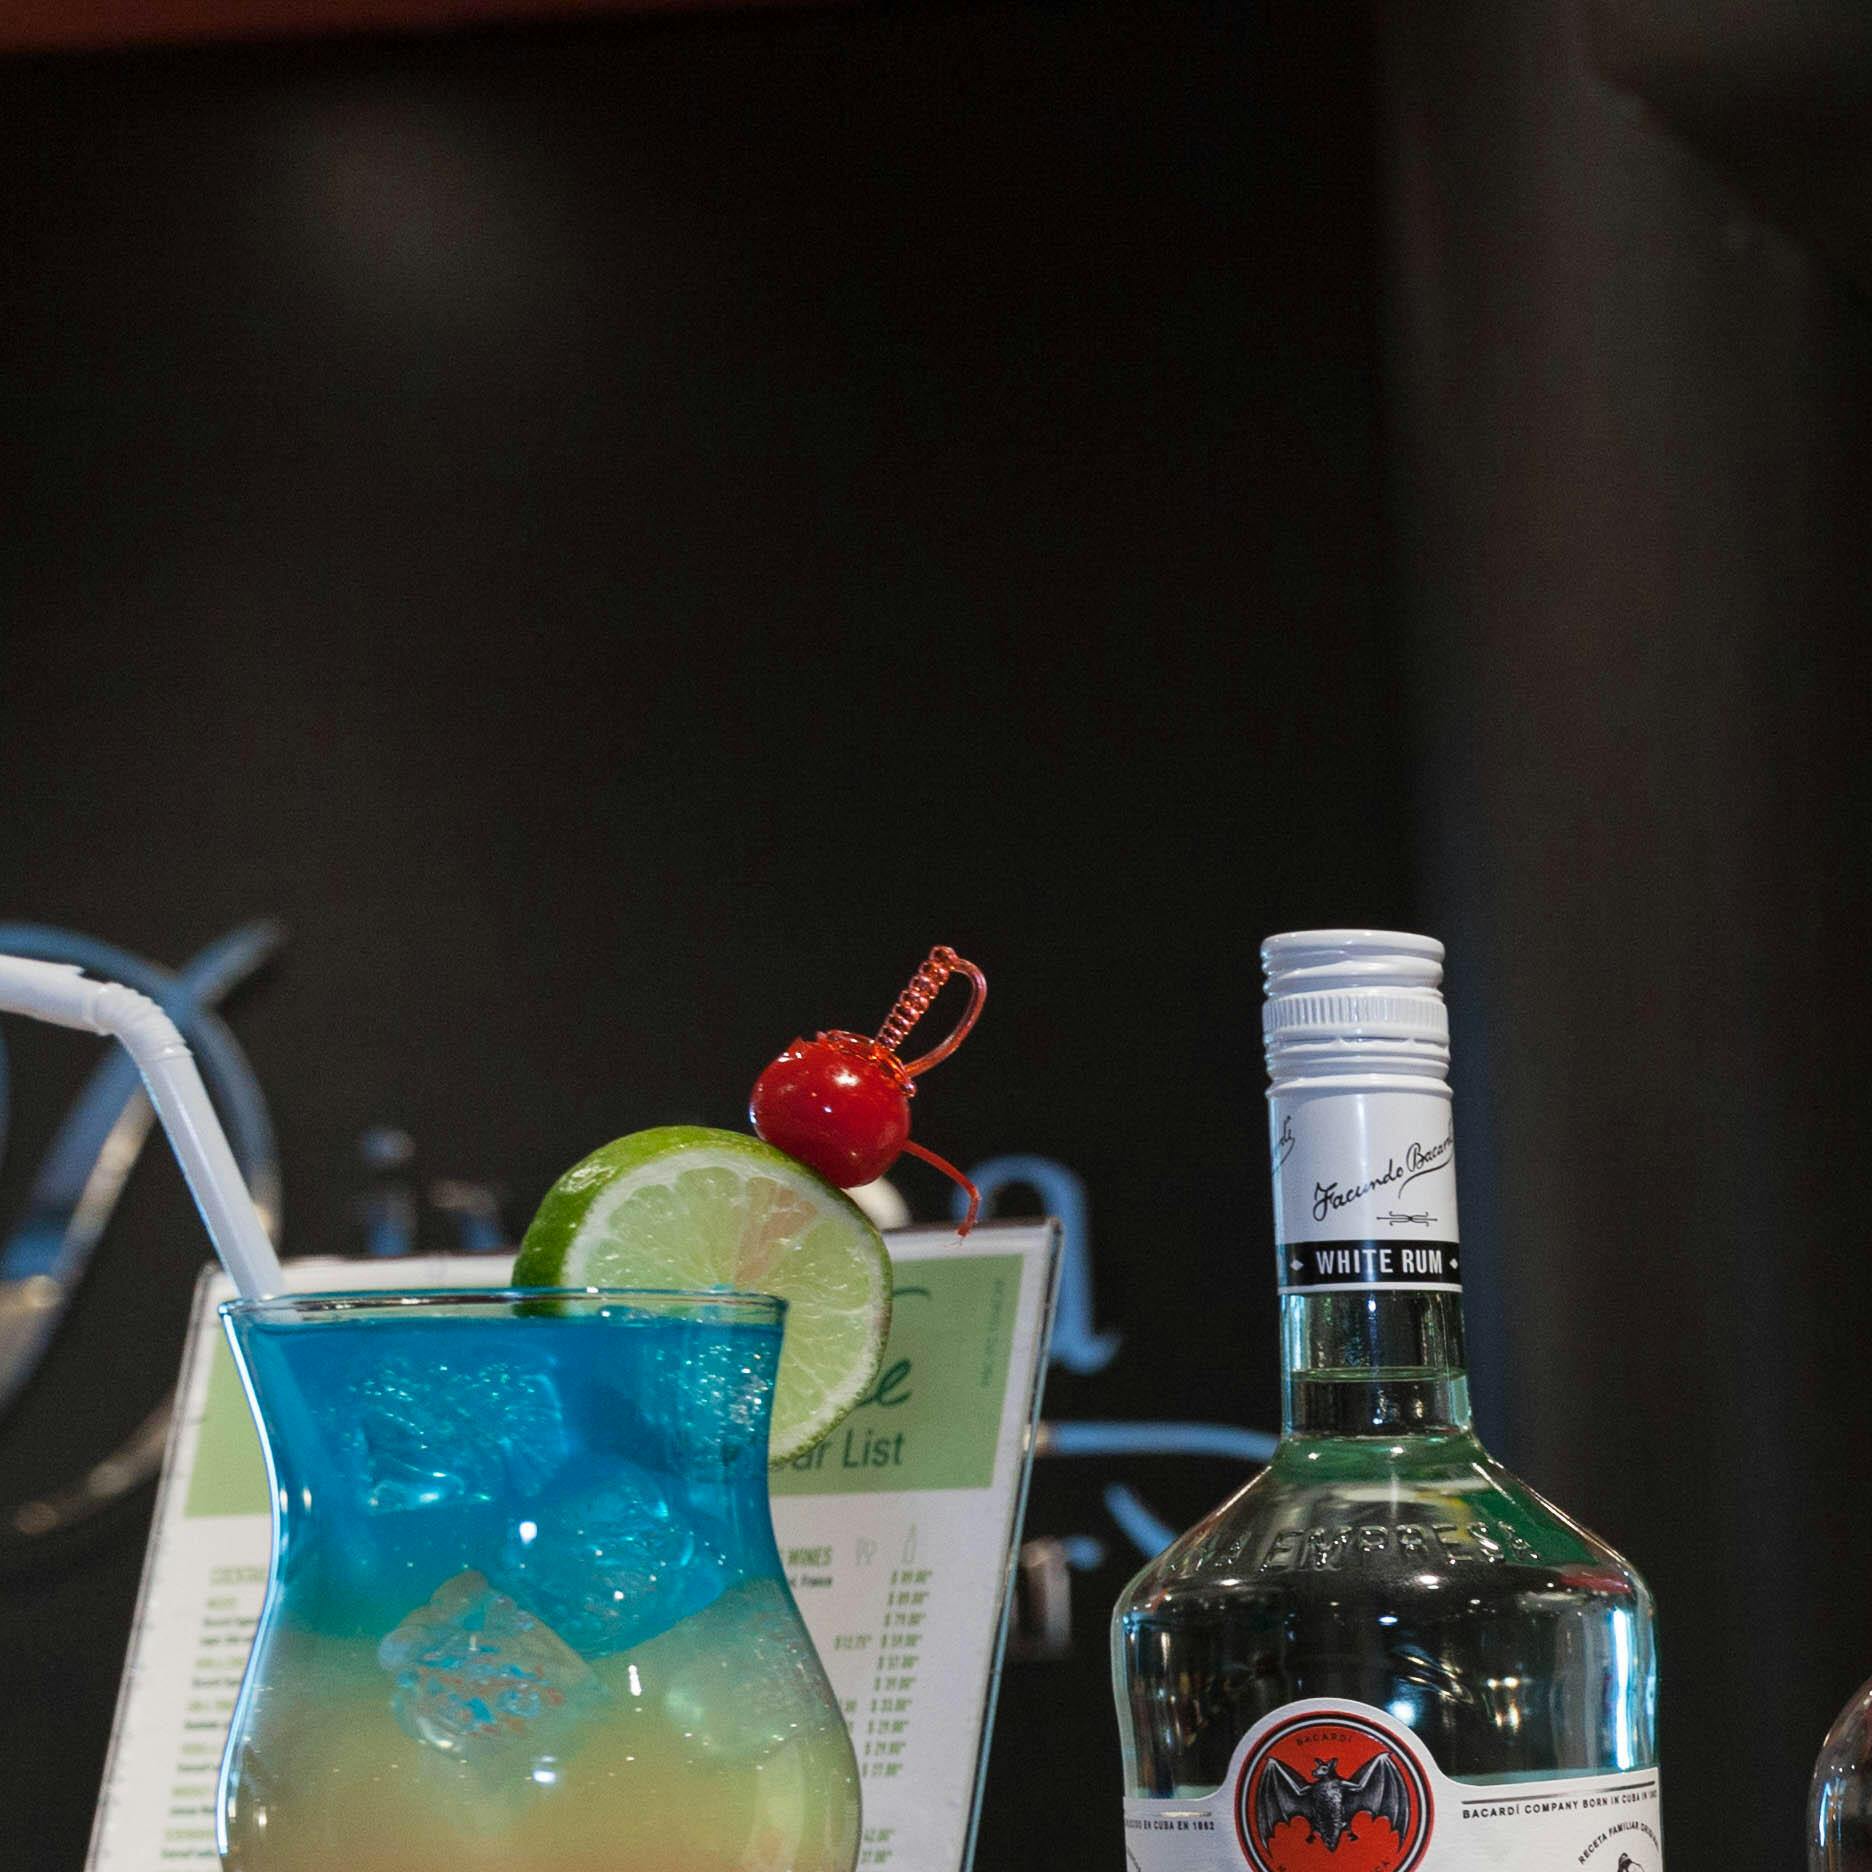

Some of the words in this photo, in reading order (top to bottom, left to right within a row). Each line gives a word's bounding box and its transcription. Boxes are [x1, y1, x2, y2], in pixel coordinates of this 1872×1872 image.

[1313, 1159, 1404, 1222] Facundo
[1316, 1249, 1393, 1275] WHITE
[1401, 1250, 1443, 1274] RUM
[842, 1430, 905, 1469] List
[1462, 1804, 1520, 1819] BACARDÍ
[1524, 1800, 1579, 1815] COMPANY
[1583, 1796, 1609, 1808] BORN
[1153, 1820, 1175, 1831] CUBA
[1177, 1820, 1189, 1831] EN
[1578, 1833, 1608, 1865] RECETA
[1608, 1820, 1640, 1838] FAMILIAR
